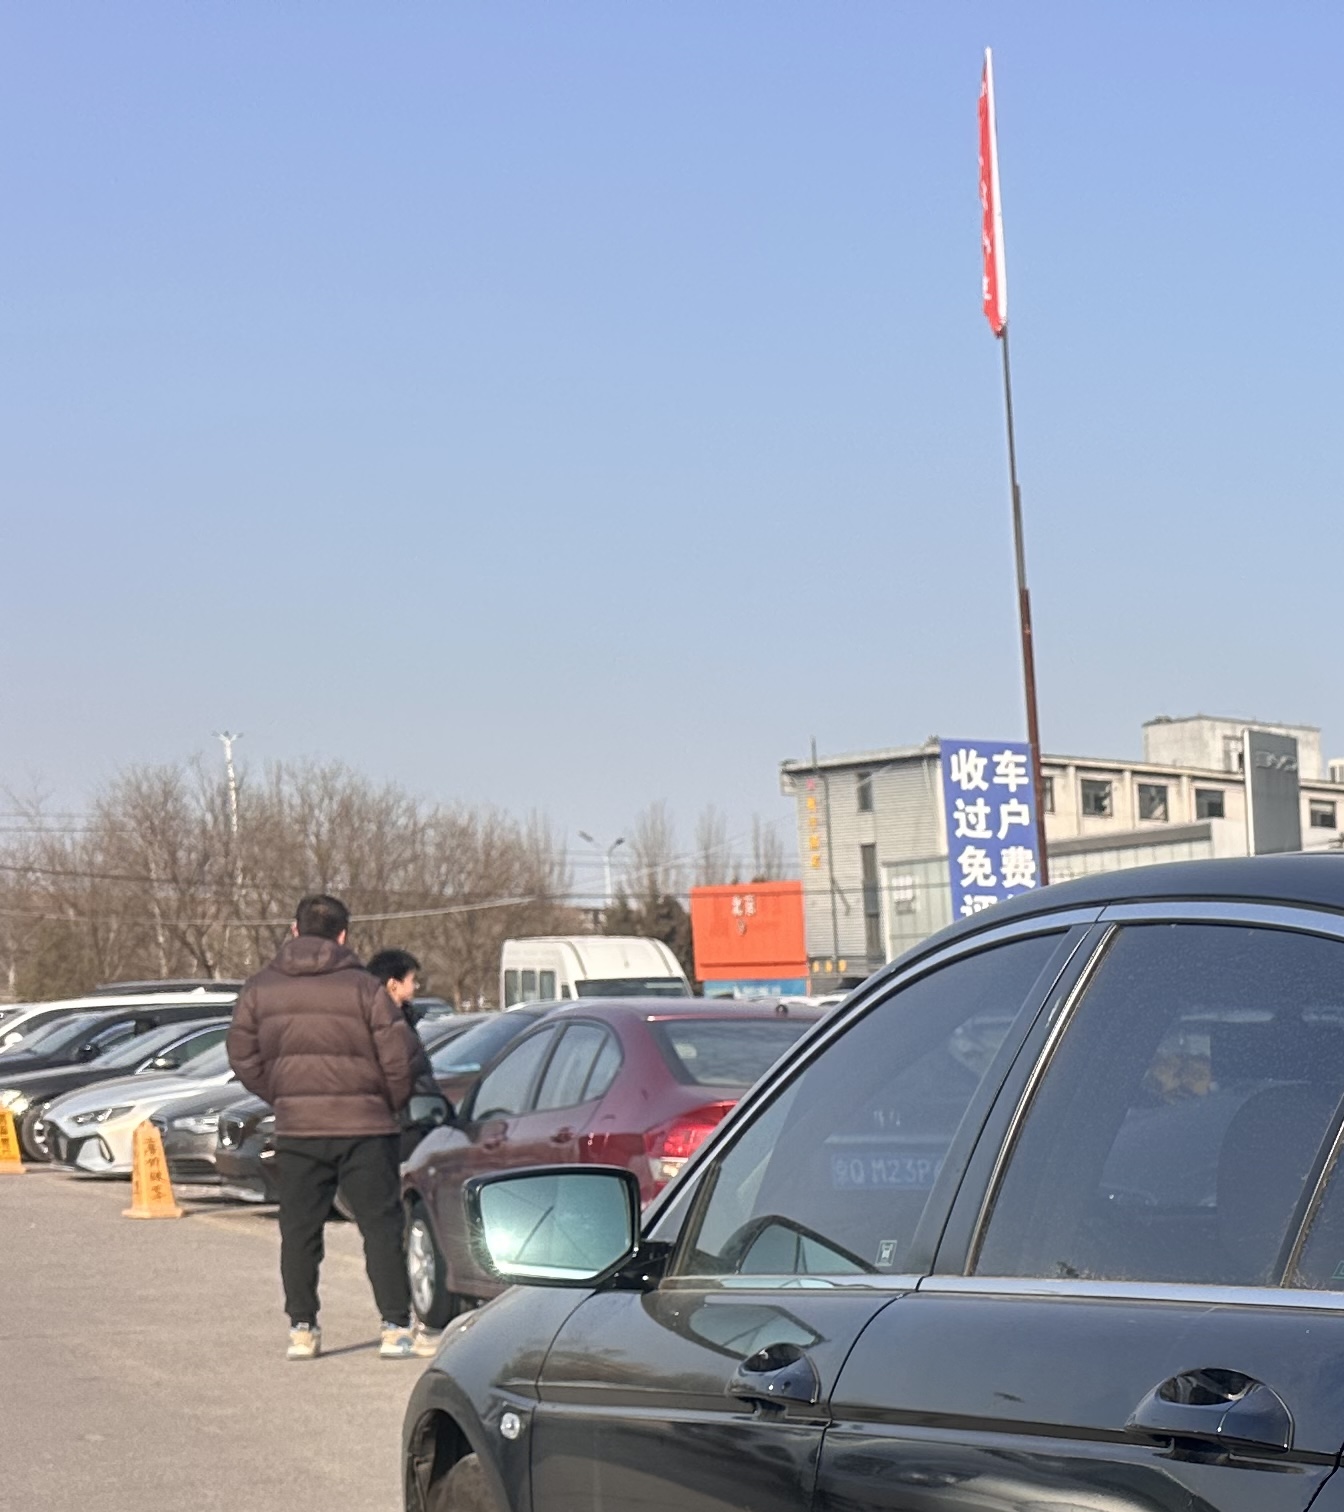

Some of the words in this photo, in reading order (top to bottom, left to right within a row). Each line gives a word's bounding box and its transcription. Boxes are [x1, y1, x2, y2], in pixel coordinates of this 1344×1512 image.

[950, 748, 1029, 792] 收车
[953, 798, 1030, 840] 过户
[957, 845, 1036, 889] 免费
